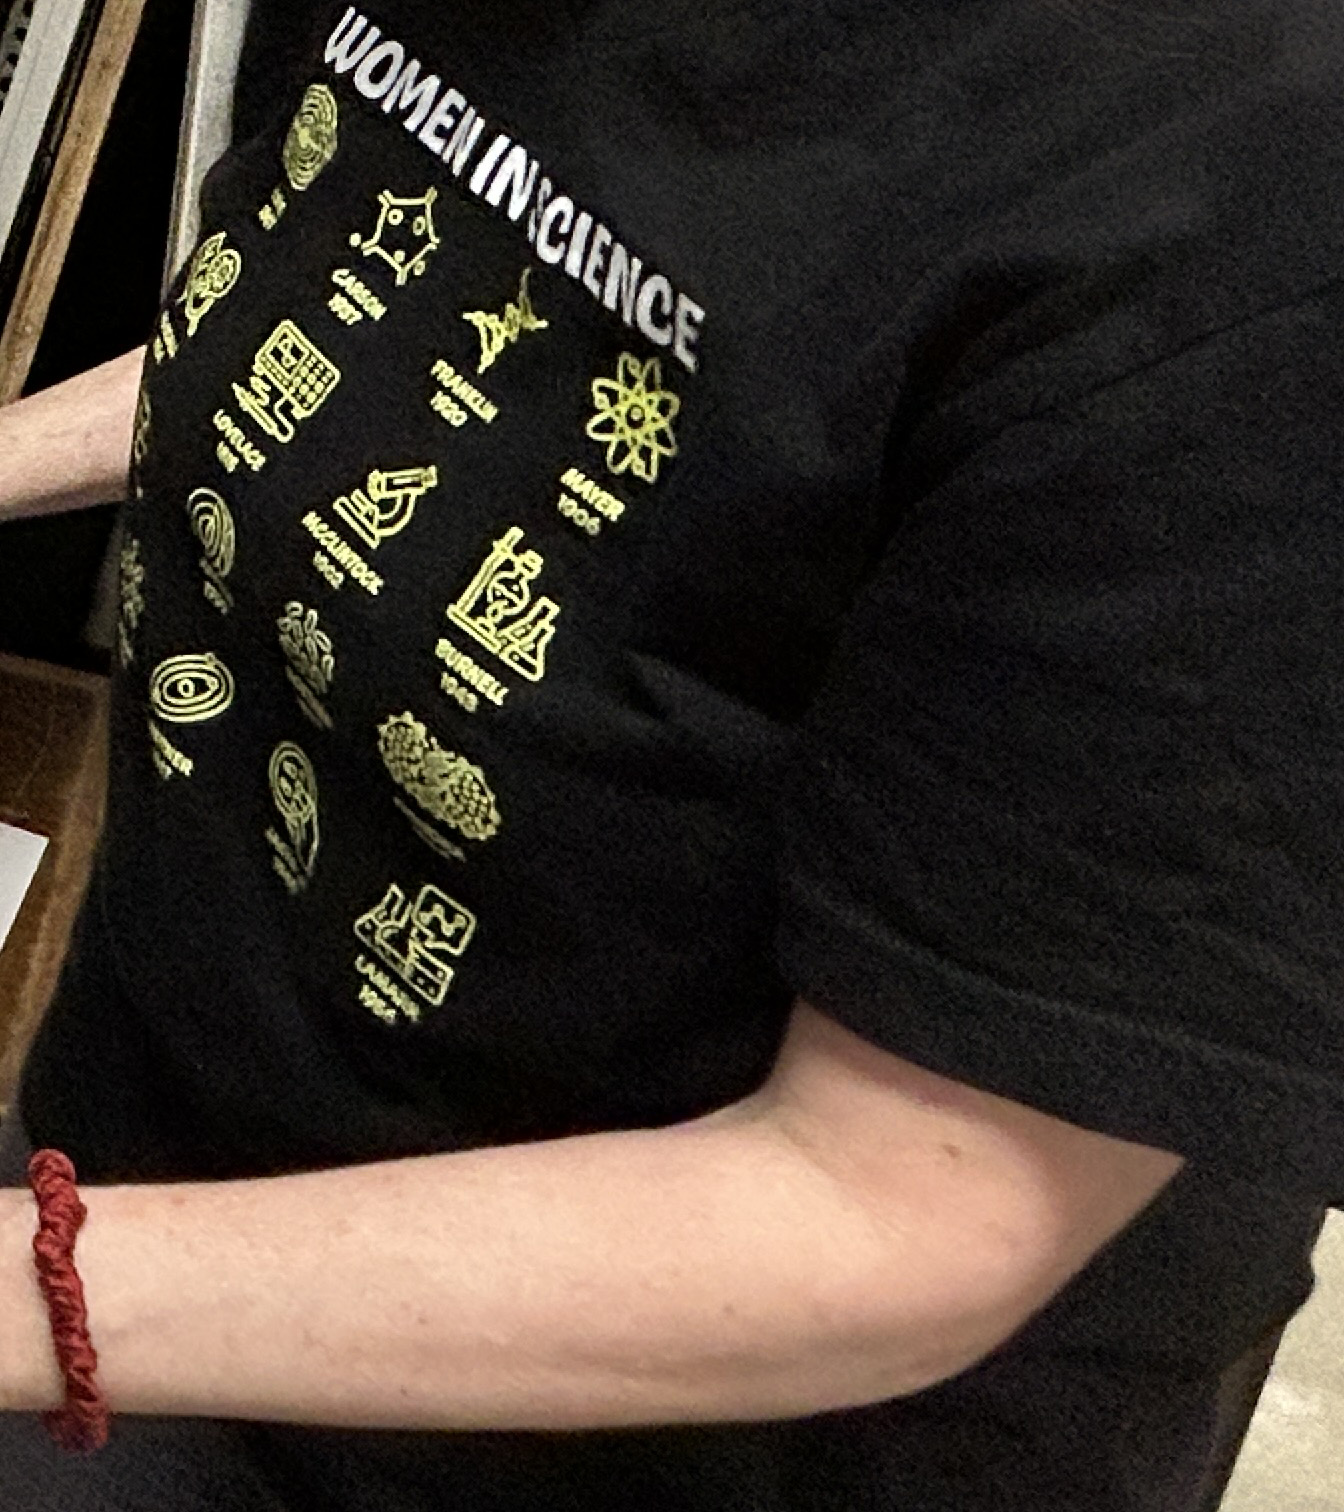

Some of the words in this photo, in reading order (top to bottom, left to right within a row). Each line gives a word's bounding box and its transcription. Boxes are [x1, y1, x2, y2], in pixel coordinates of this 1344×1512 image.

[323, 5, 486, 178] WOMEN
[468, 133, 540, 223] IN
[526, 176, 707, 375] SCIENCE
[331, 267, 388, 322] CARSON
[429, 358, 500, 425] FRANKLIN
[429, 390, 469, 428] 1920
[556, 492, 603, 537] 1906
[559, 466, 627, 523] MAYER
[301, 510, 385, 596] MCCLINTOCK
[434, 638, 510, 707] BURNELL
